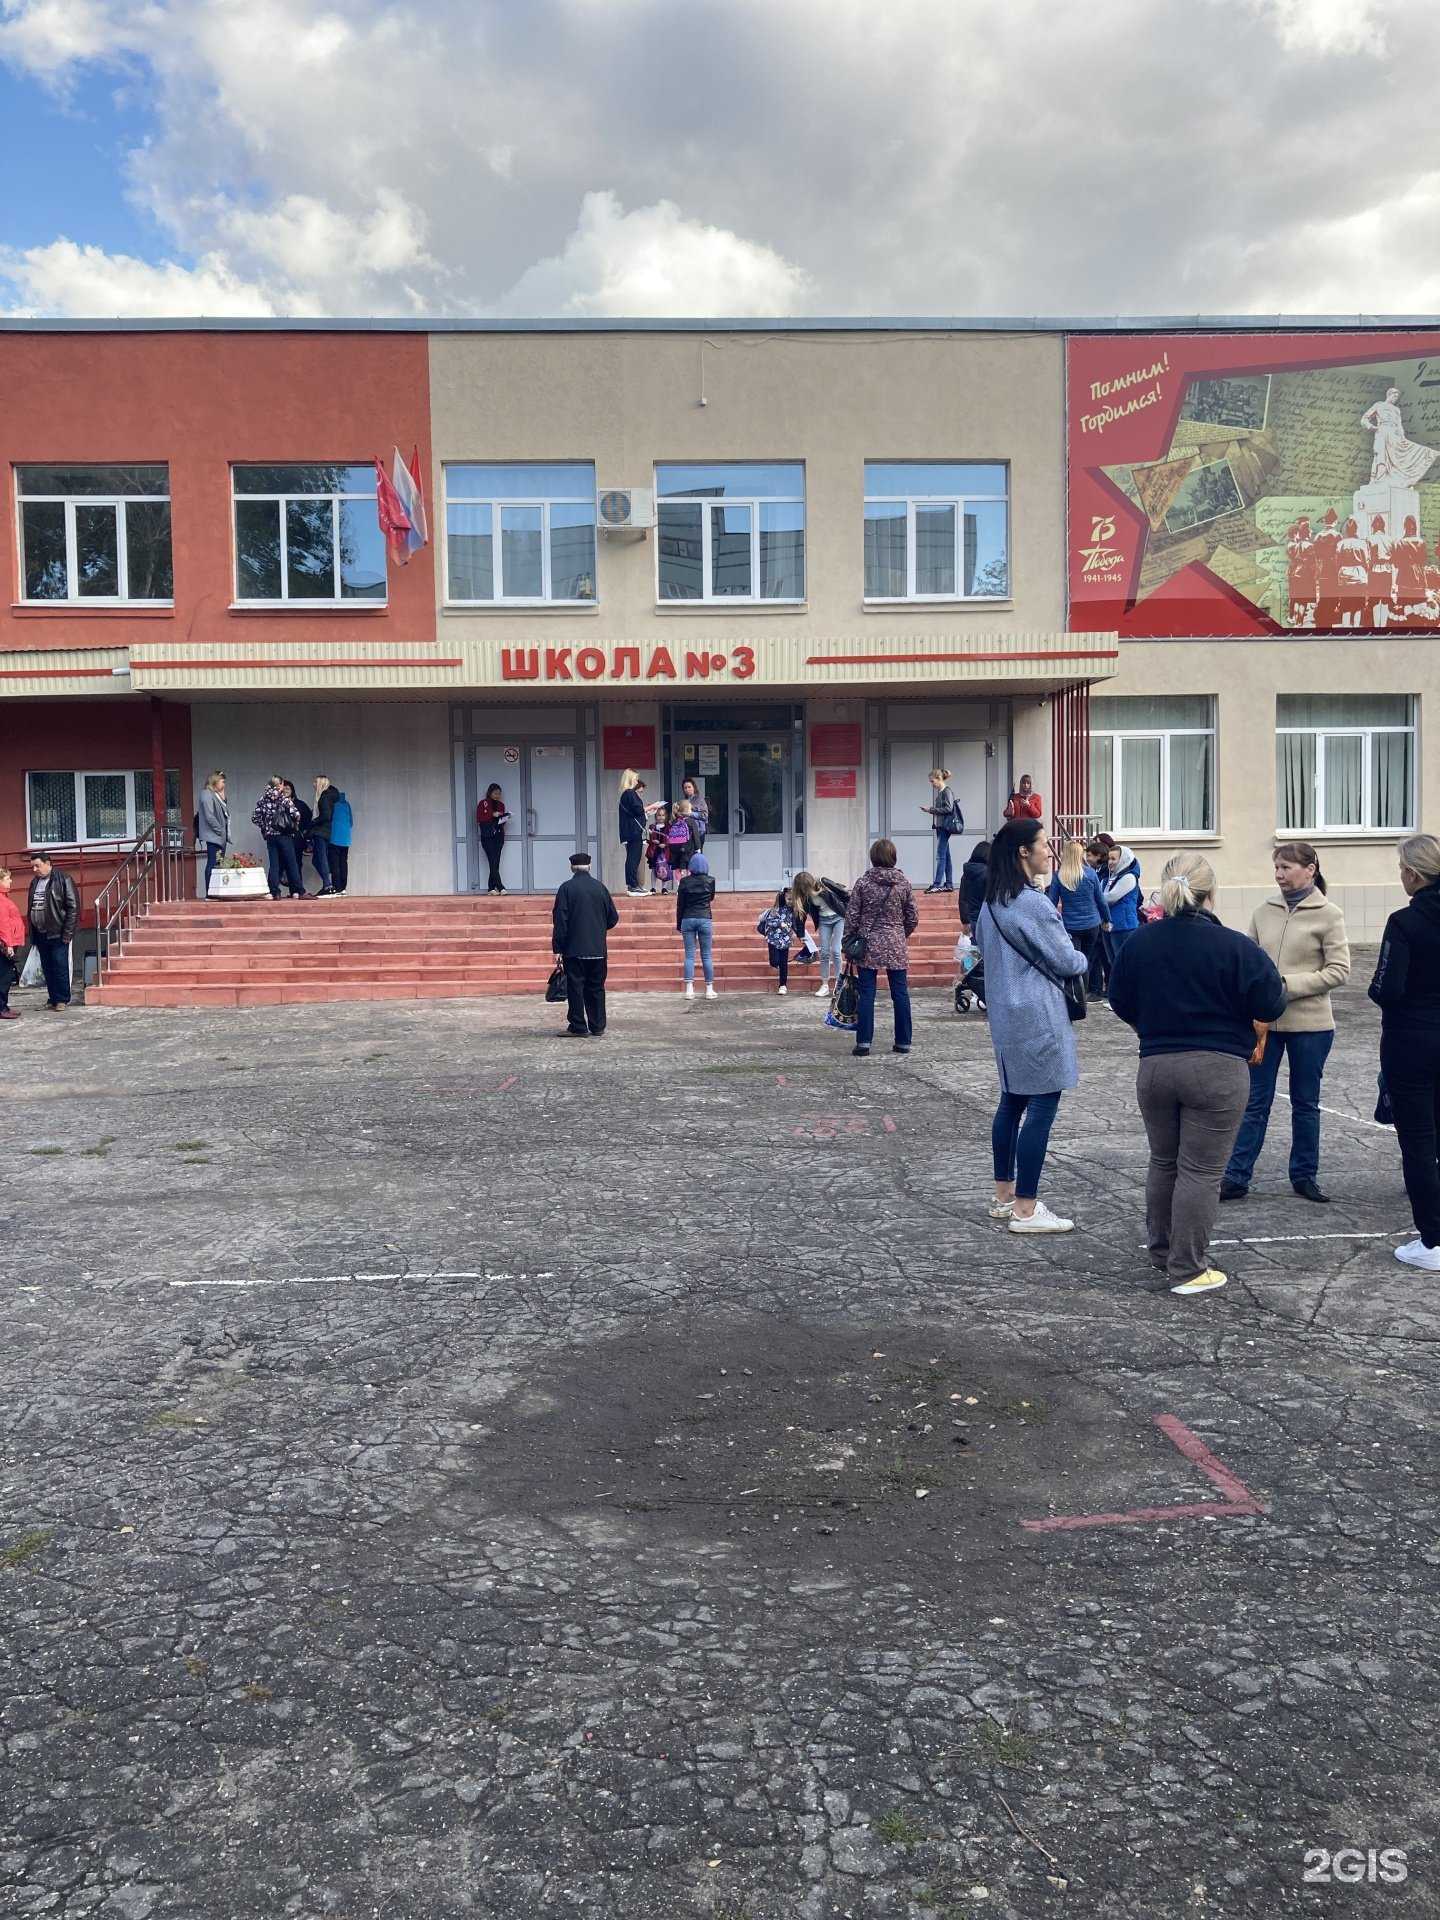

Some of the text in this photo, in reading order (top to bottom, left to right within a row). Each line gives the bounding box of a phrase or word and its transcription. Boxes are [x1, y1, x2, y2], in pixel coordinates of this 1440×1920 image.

[1090, 352, 1170, 400] Помним!
[1080, 382, 1162, 433] Гордимся!
[1091, 515, 1116, 541] 75
[1078, 543, 1125, 573] Победа
[1083, 574, 1122, 583] 1941-1945
[501, 646, 677, 680] ШКОЛА
